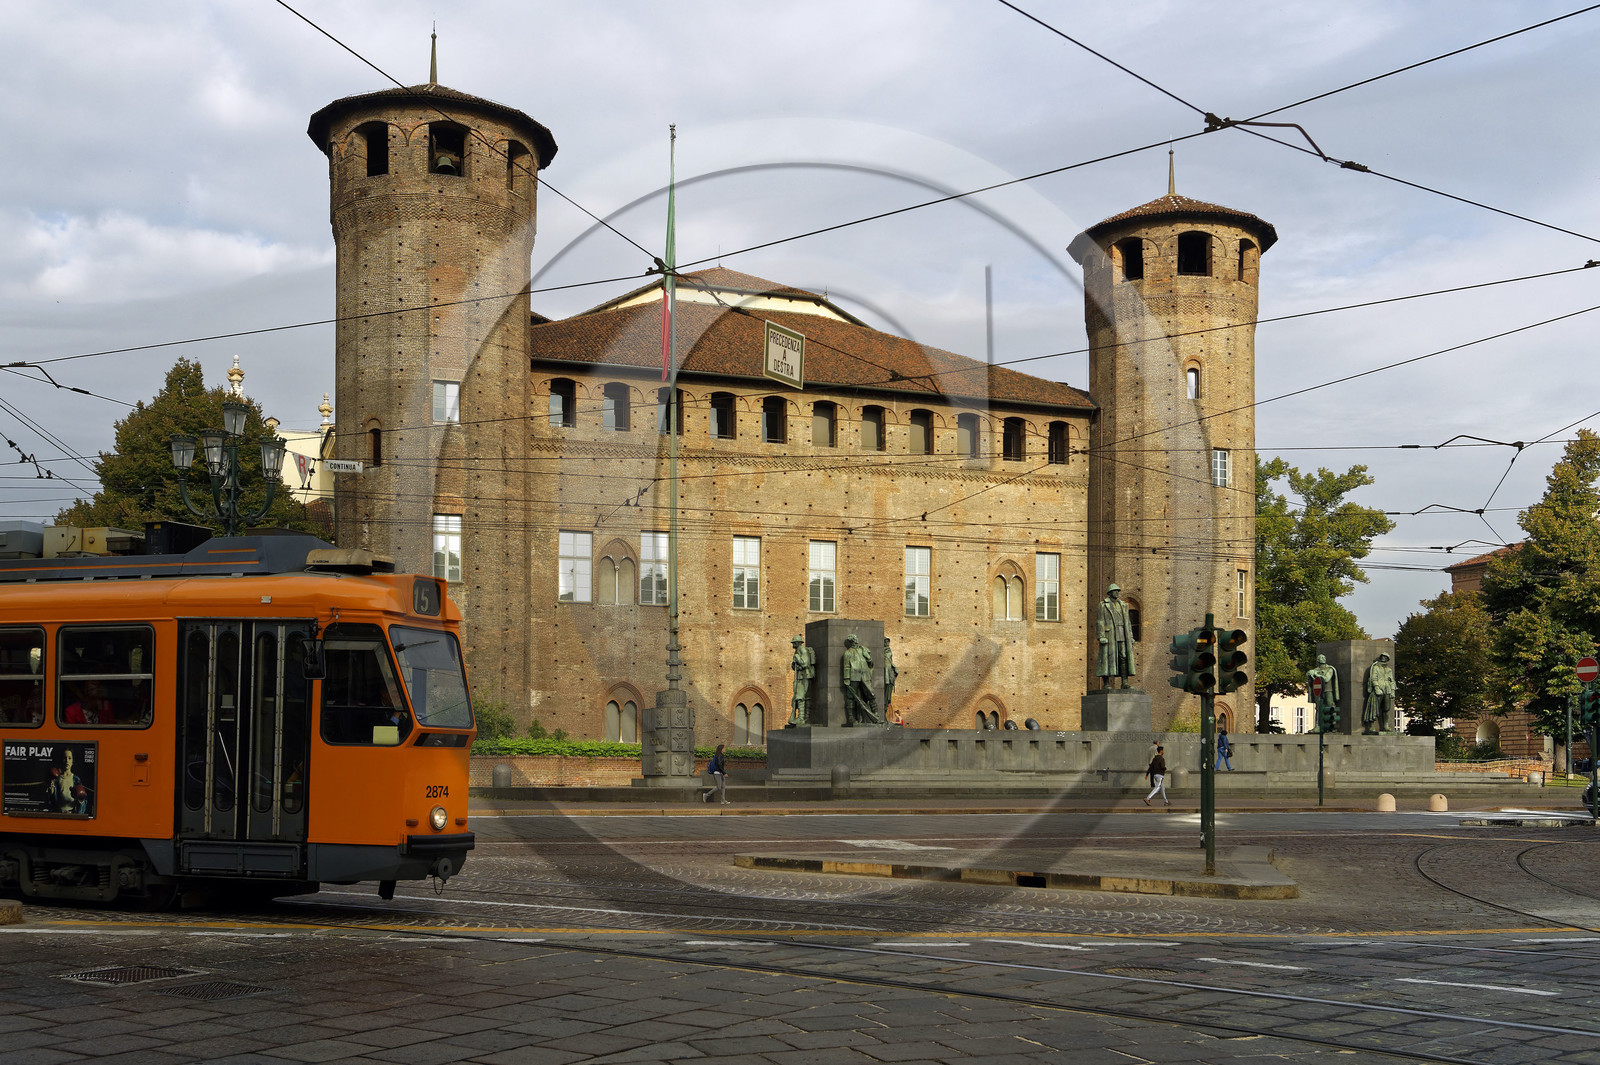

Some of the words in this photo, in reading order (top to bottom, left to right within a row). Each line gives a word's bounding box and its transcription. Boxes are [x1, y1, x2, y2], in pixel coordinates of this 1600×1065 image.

[769, 330, 800, 353] PRECEDENZA
[782, 349, 787, 361] A
[773, 359, 794, 377] DESTRA
[298, 455, 307, 474] R
[414, 586, 430, 612] 15
[5, 746, 26, 757] FAIR
[29, 746, 53, 757] PLAY
[425, 785, 449, 798] 2874
